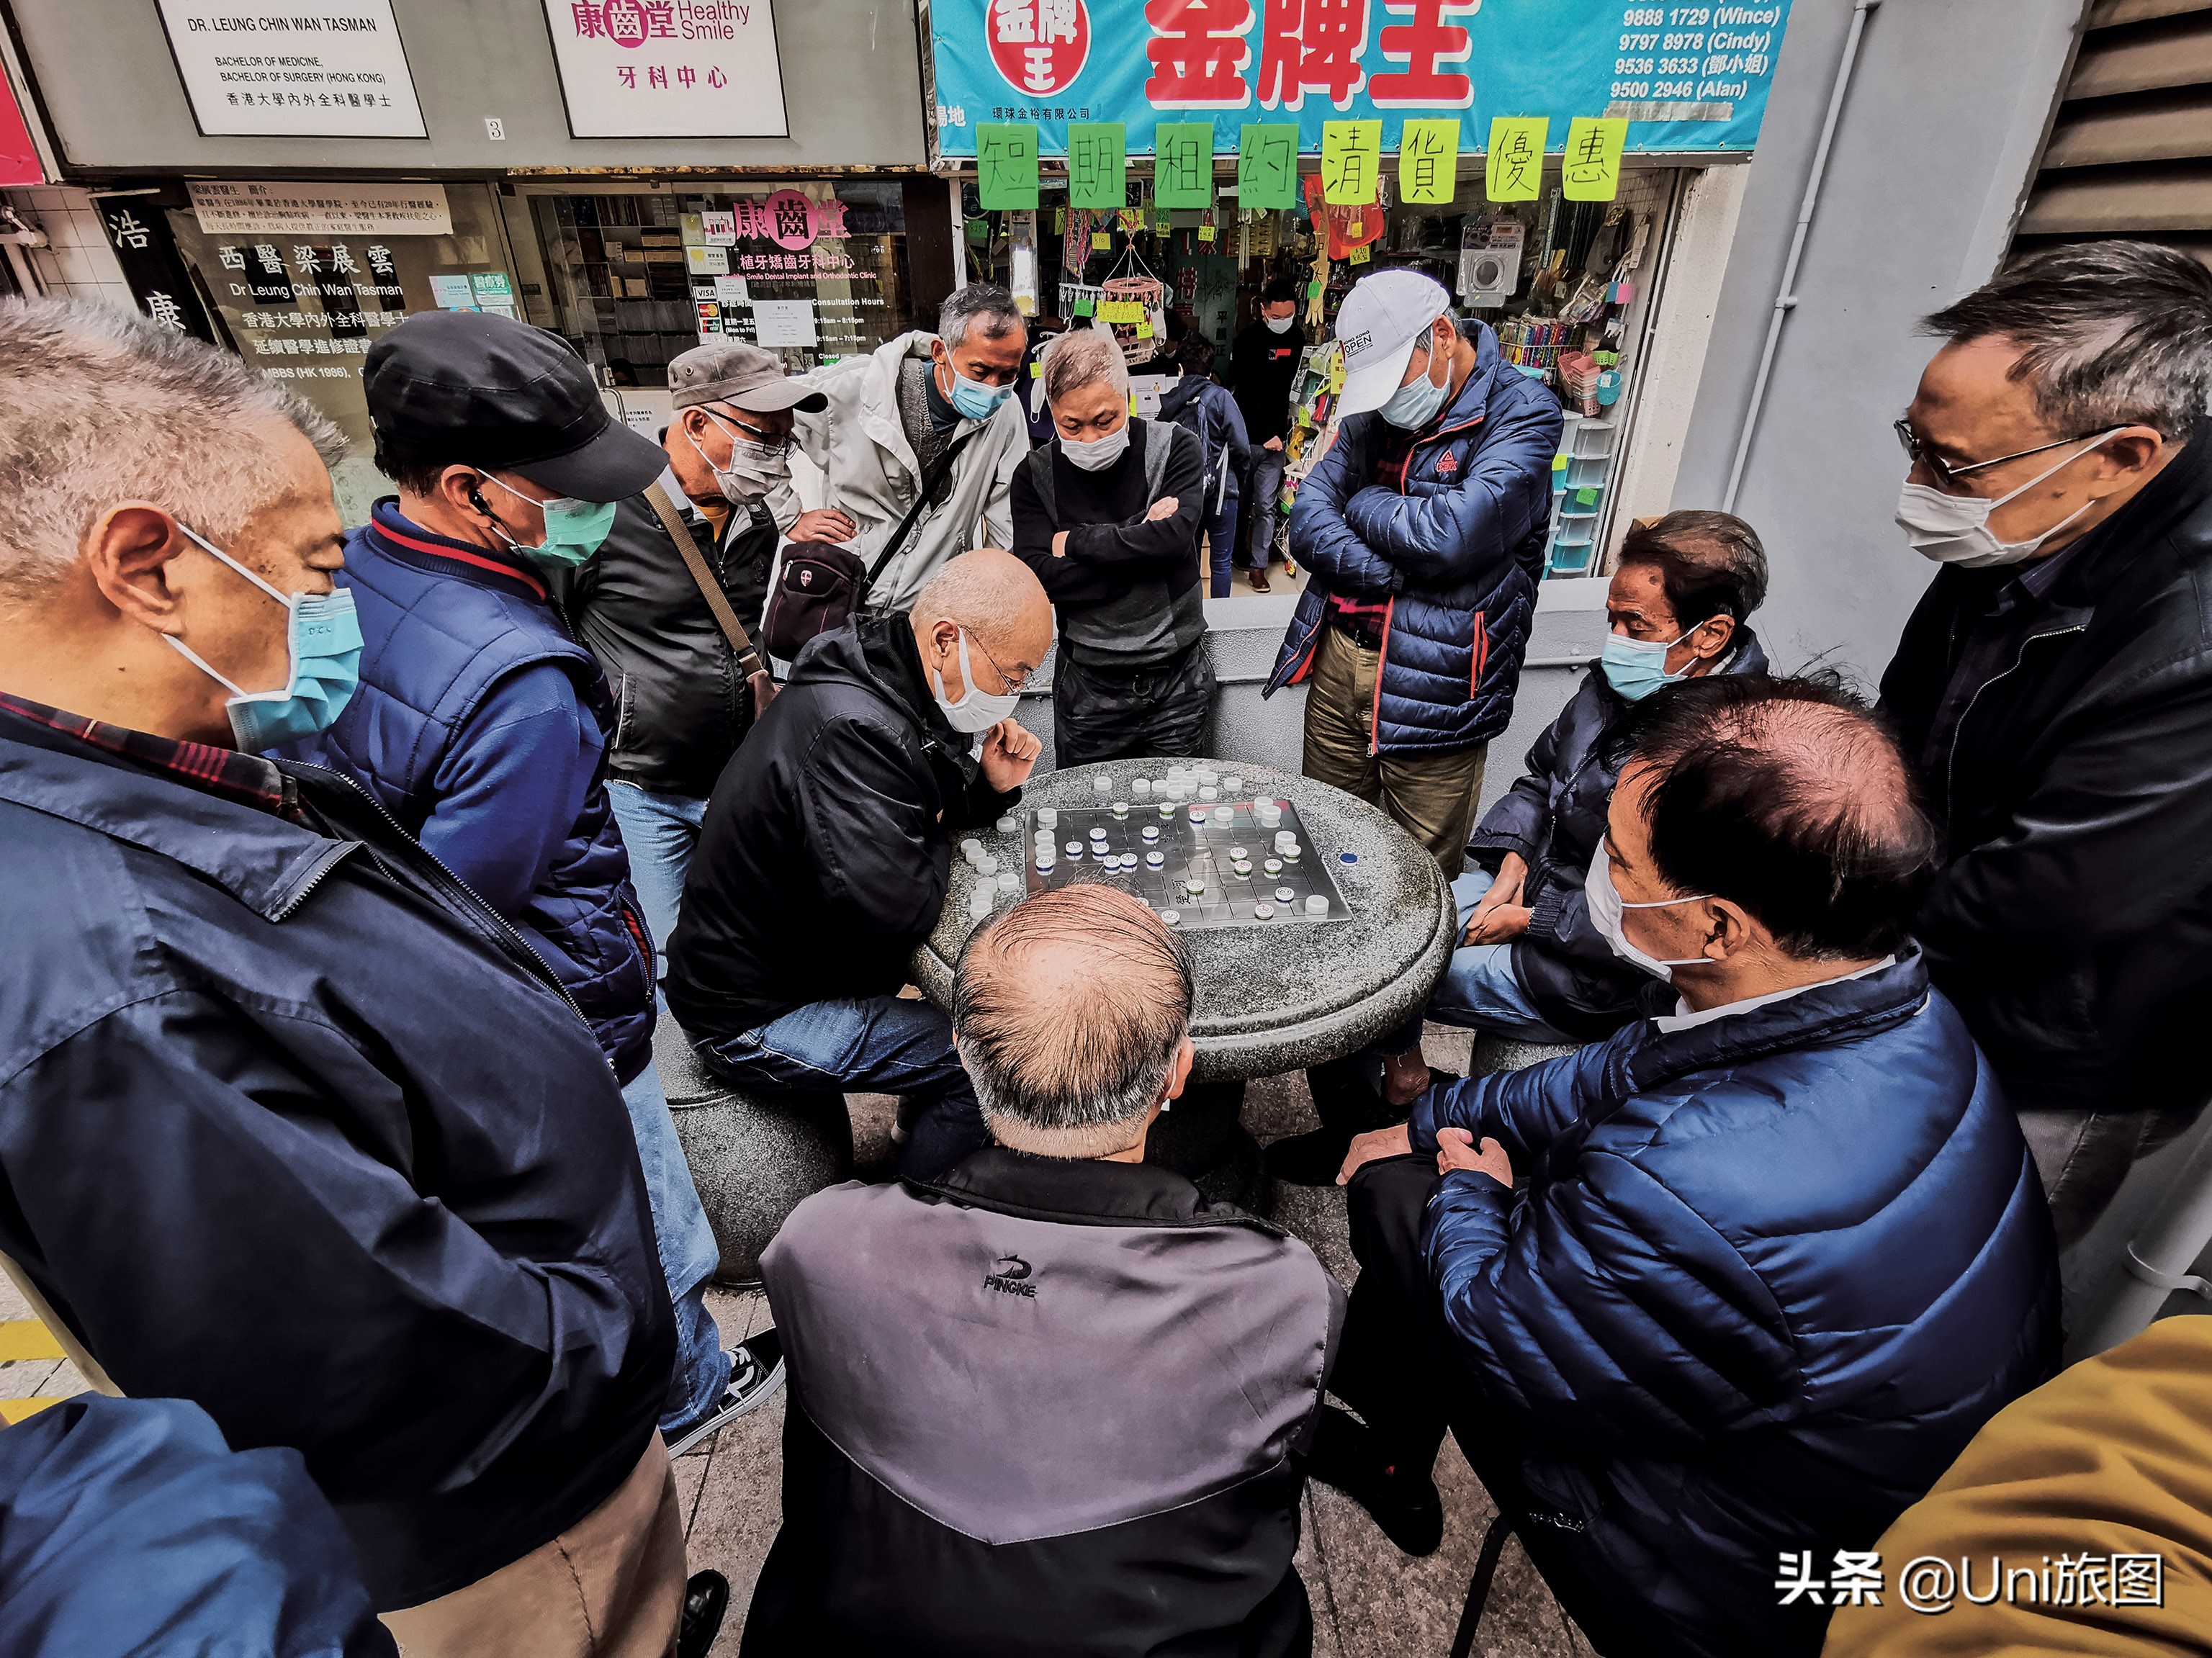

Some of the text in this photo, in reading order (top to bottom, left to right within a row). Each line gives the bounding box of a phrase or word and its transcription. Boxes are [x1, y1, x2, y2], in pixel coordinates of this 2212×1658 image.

[571, 0, 678, 39] 康齒堂
[678, 0, 750, 25] Healthy
[995, 0, 1077, 44] 金牌
[1623, 6, 1780, 28] 9888 1729 (Wince)
[188, 17, 377, 32] DR. LEUNG CHIN WAN TASMAN
[681, 20, 734, 40] Smile
[1619, 32, 1771, 53] 9797 8978 (Cindy)
[215, 57, 323, 68] BACHELOR OF MEDICINE,
[1144, 0, 1474, 112] 金牌王
[1024, 48, 1056, 91] 王
[1614, 58, 1654, 75] 9536
[1658, 58, 1699, 74] 3633
[220, 73, 386, 85] BACHELOR OF SURGERY (HONG KONG)
[616, 65, 727, 89] 牙科中心
[1611, 80, 1748, 100] 9500 2946 (Alan)
[490, 121, 501, 138] 3
[733, 199, 851, 240] 康齒堂
[219, 244, 395, 274] 西醫梁展雲
[740, 253, 855, 270] 植牙矯齒牙科中心
[229, 284, 403, 298] Dr Leung Chin Wan Tasman
[1345, 334, 1372, 353] OPEN
[264, 368, 295, 378] MBBS
[297, 367, 319, 379] (HK
